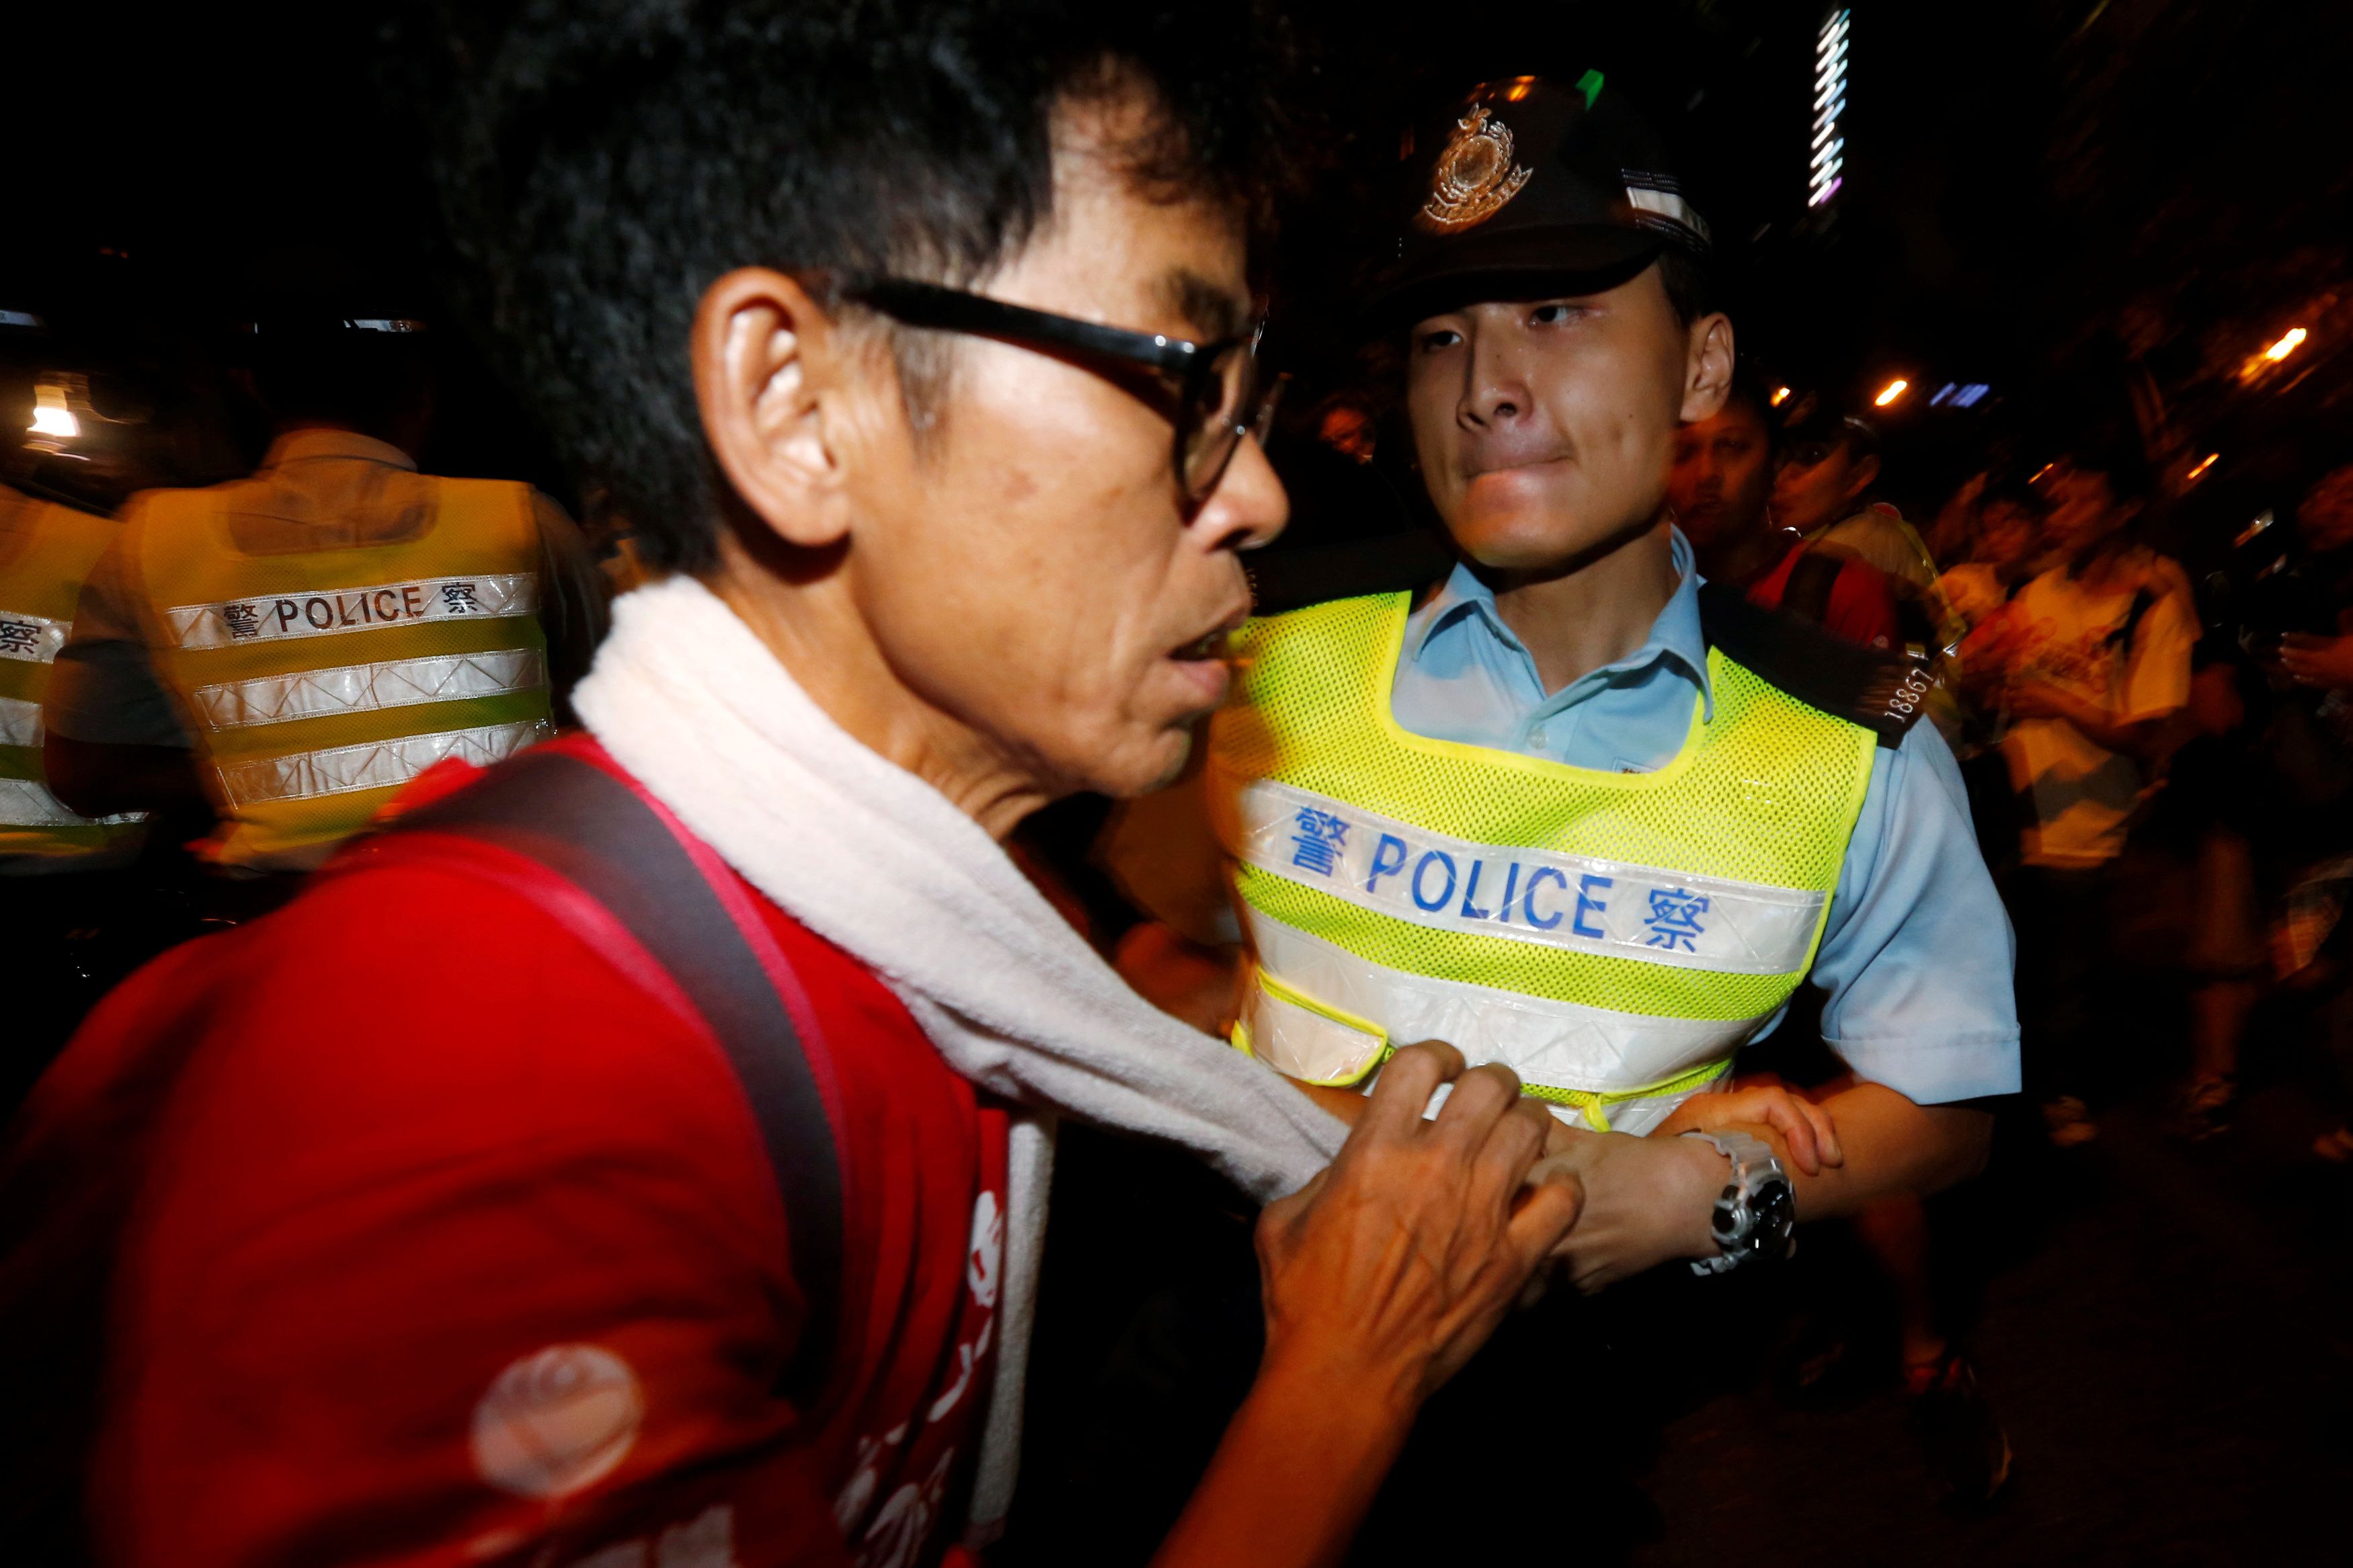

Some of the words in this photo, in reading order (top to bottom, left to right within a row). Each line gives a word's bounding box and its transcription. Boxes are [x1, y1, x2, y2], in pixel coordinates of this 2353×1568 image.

[0, 620, 42, 654] 察
[224, 604, 259, 638] 警
[275, 587, 424, 632] POLICE
[441, 582, 478, 614] 察
[1884, 667, 1933, 723] 18867
[1292, 806, 1351, 877] 警
[1366, 833, 1613, 939] POLICE
[1644, 888, 1710, 953] 察
